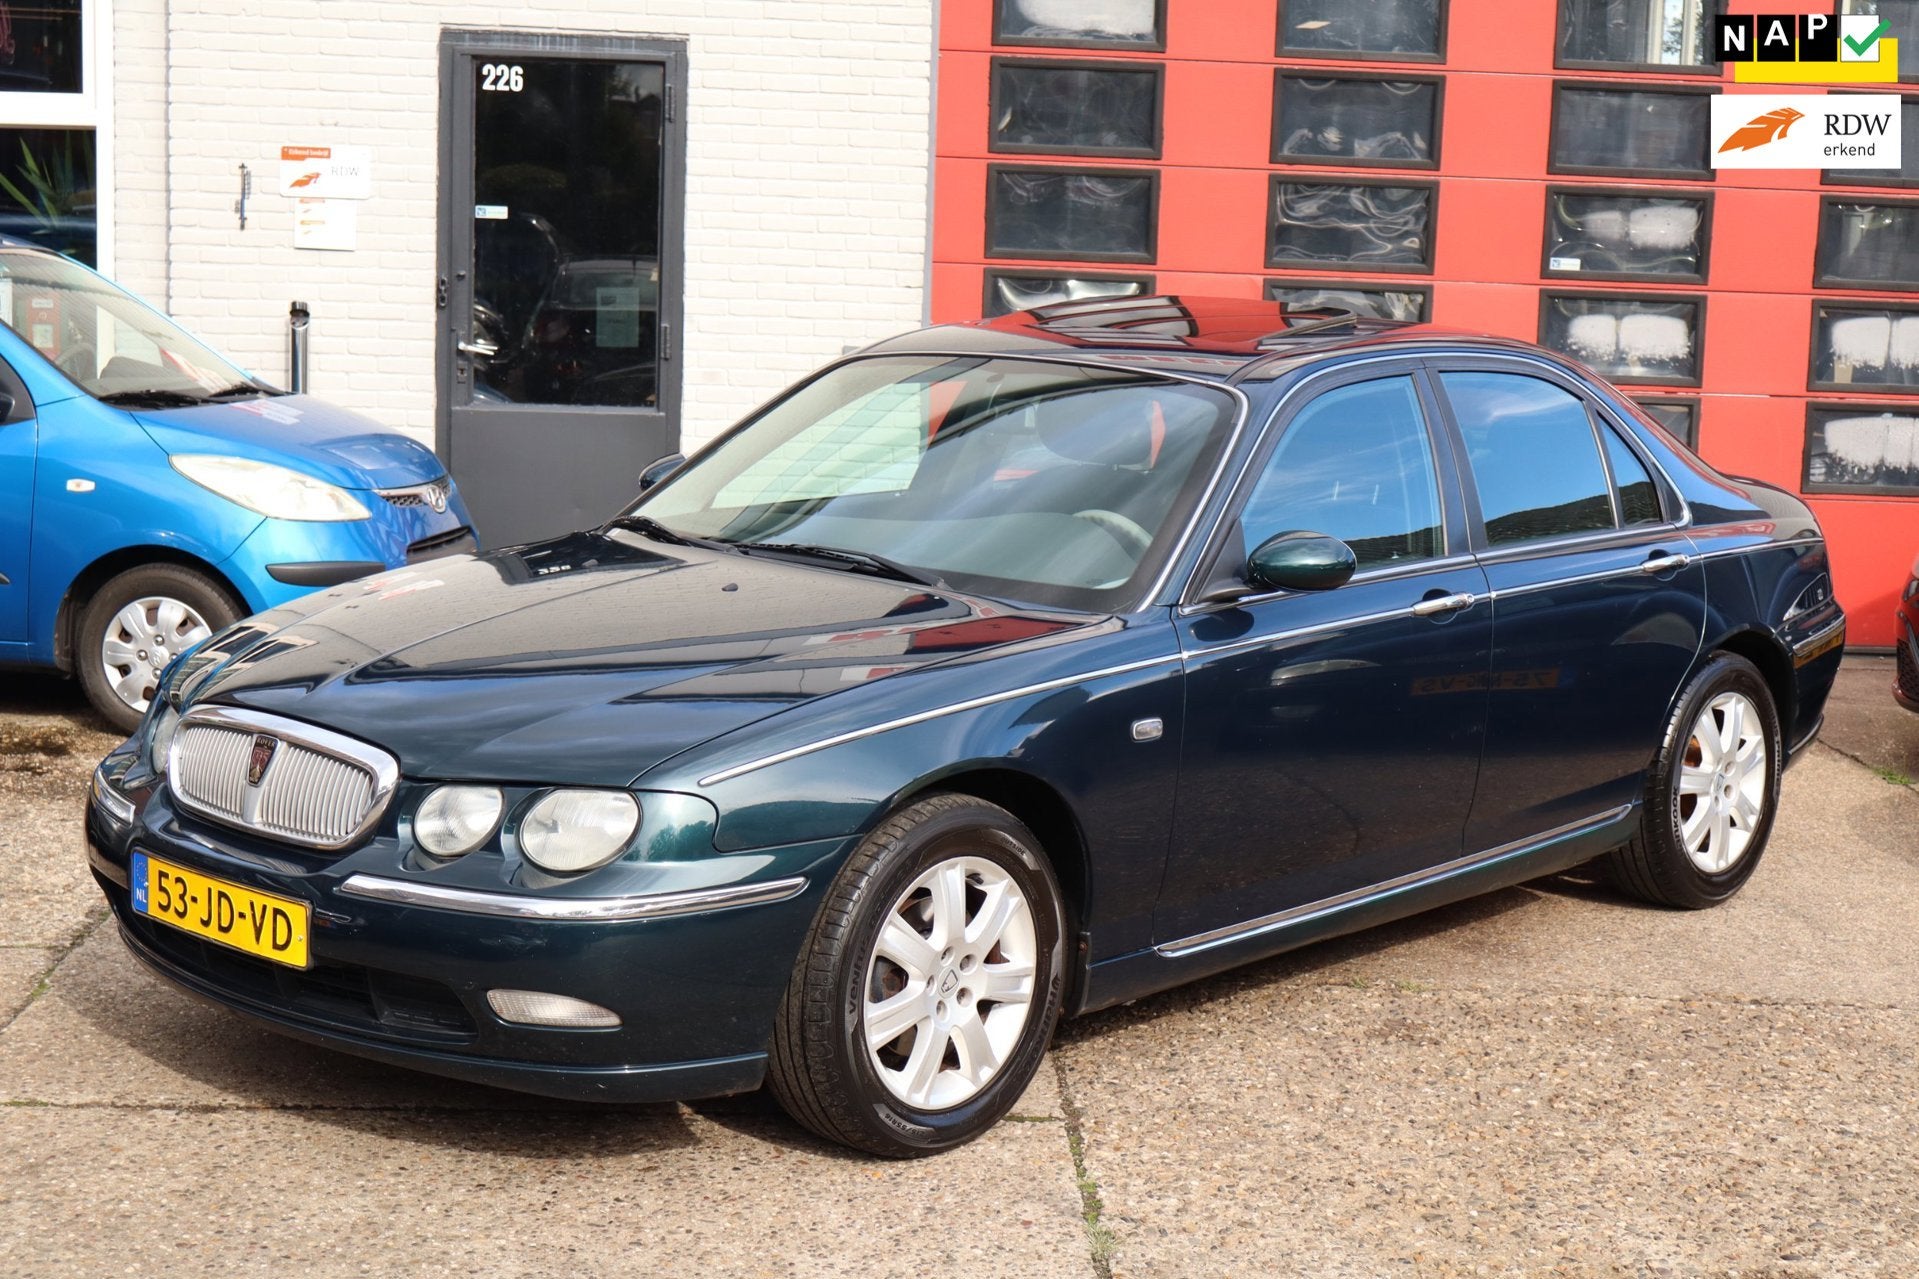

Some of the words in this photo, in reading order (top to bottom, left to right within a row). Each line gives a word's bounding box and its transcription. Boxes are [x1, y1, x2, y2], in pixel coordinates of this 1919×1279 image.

[482, 64, 524, 92] 226
[256, 736, 276, 748] ROVER
[136, 887, 147, 903] NL
[158, 869, 293, 952] 53-JD-VD
